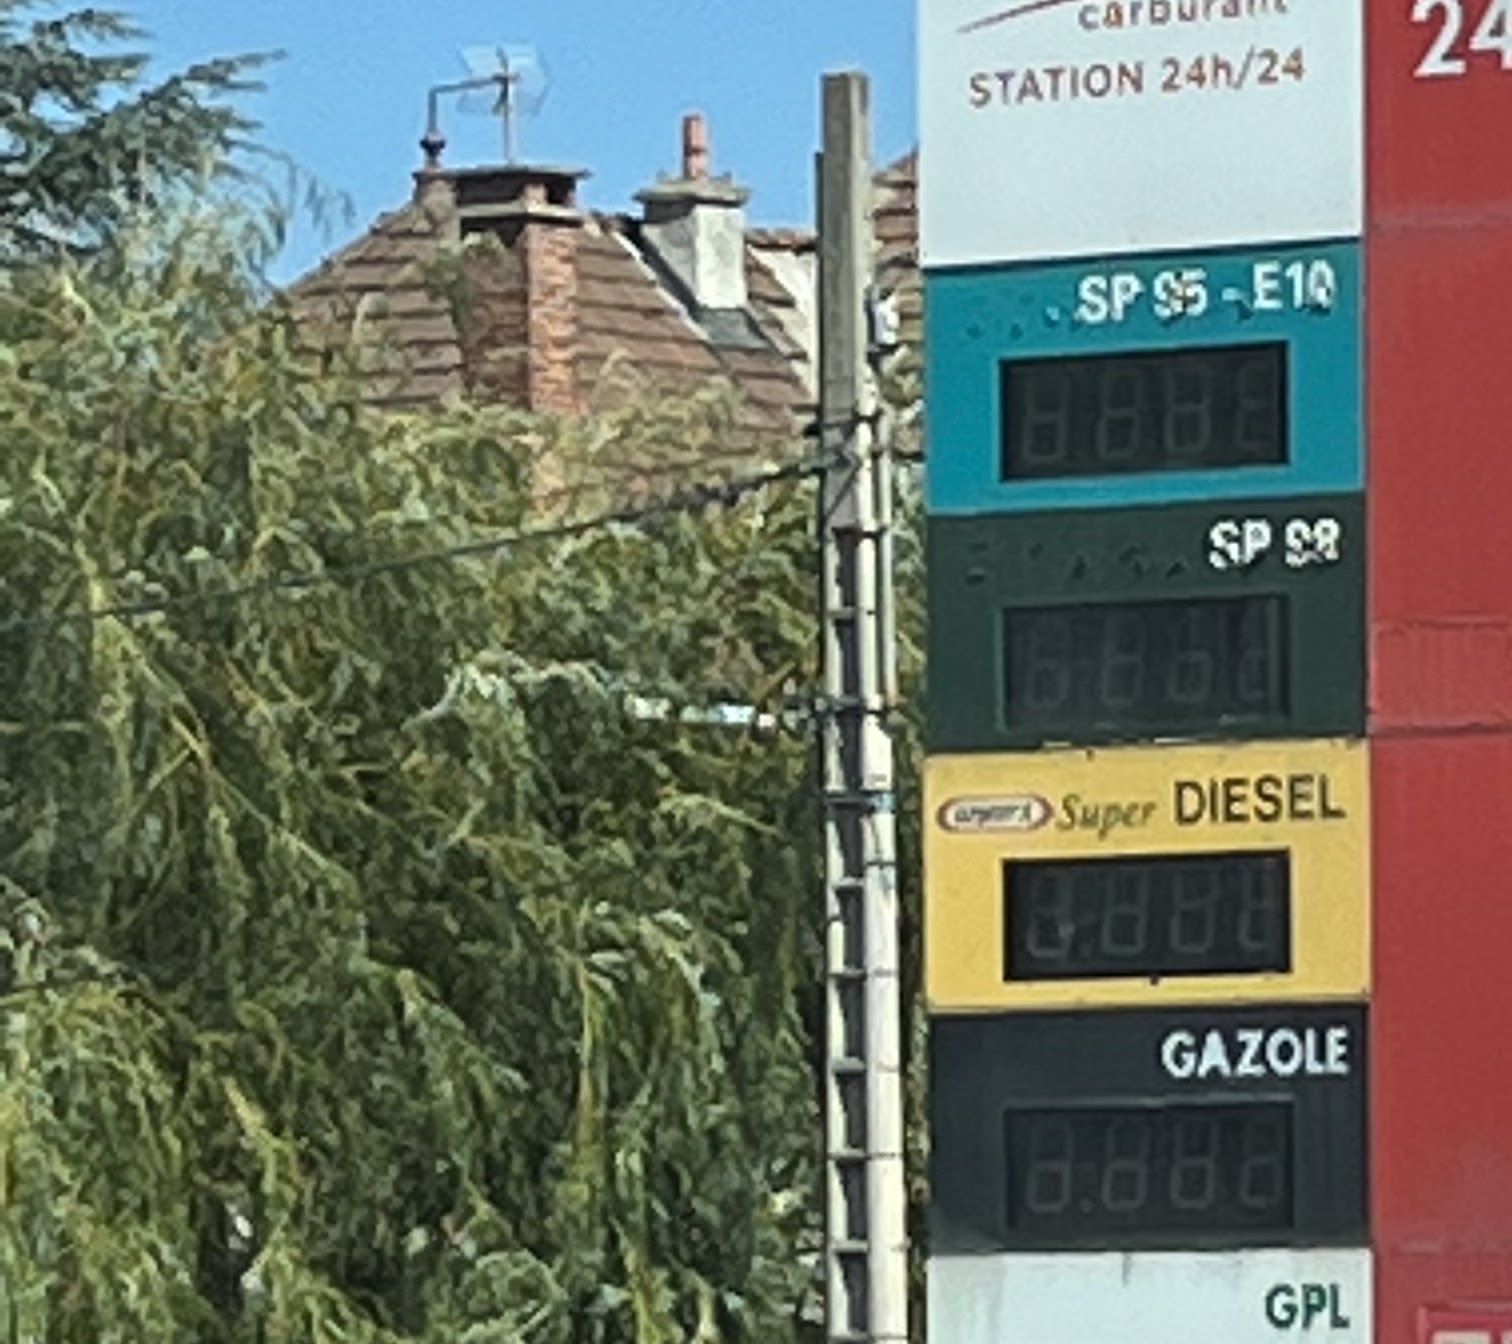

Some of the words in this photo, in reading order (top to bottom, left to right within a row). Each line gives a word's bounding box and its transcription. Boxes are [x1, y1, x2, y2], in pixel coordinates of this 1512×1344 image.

[968, 60, 1145, 108] STATION
[1160, 45, 1306, 93] 24h/24
[1075, 272, 1145, 324] SP
[1253, 258, 1336, 310] E10
[1209, 518, 1272, 569] SP
[1055, 793, 1157, 842] Super
[1173, 773, 1346, 826] DIESEL
[1161, 1025, 1350, 1079] GAZOLE
[1264, 1283, 1351, 1330] GPL
